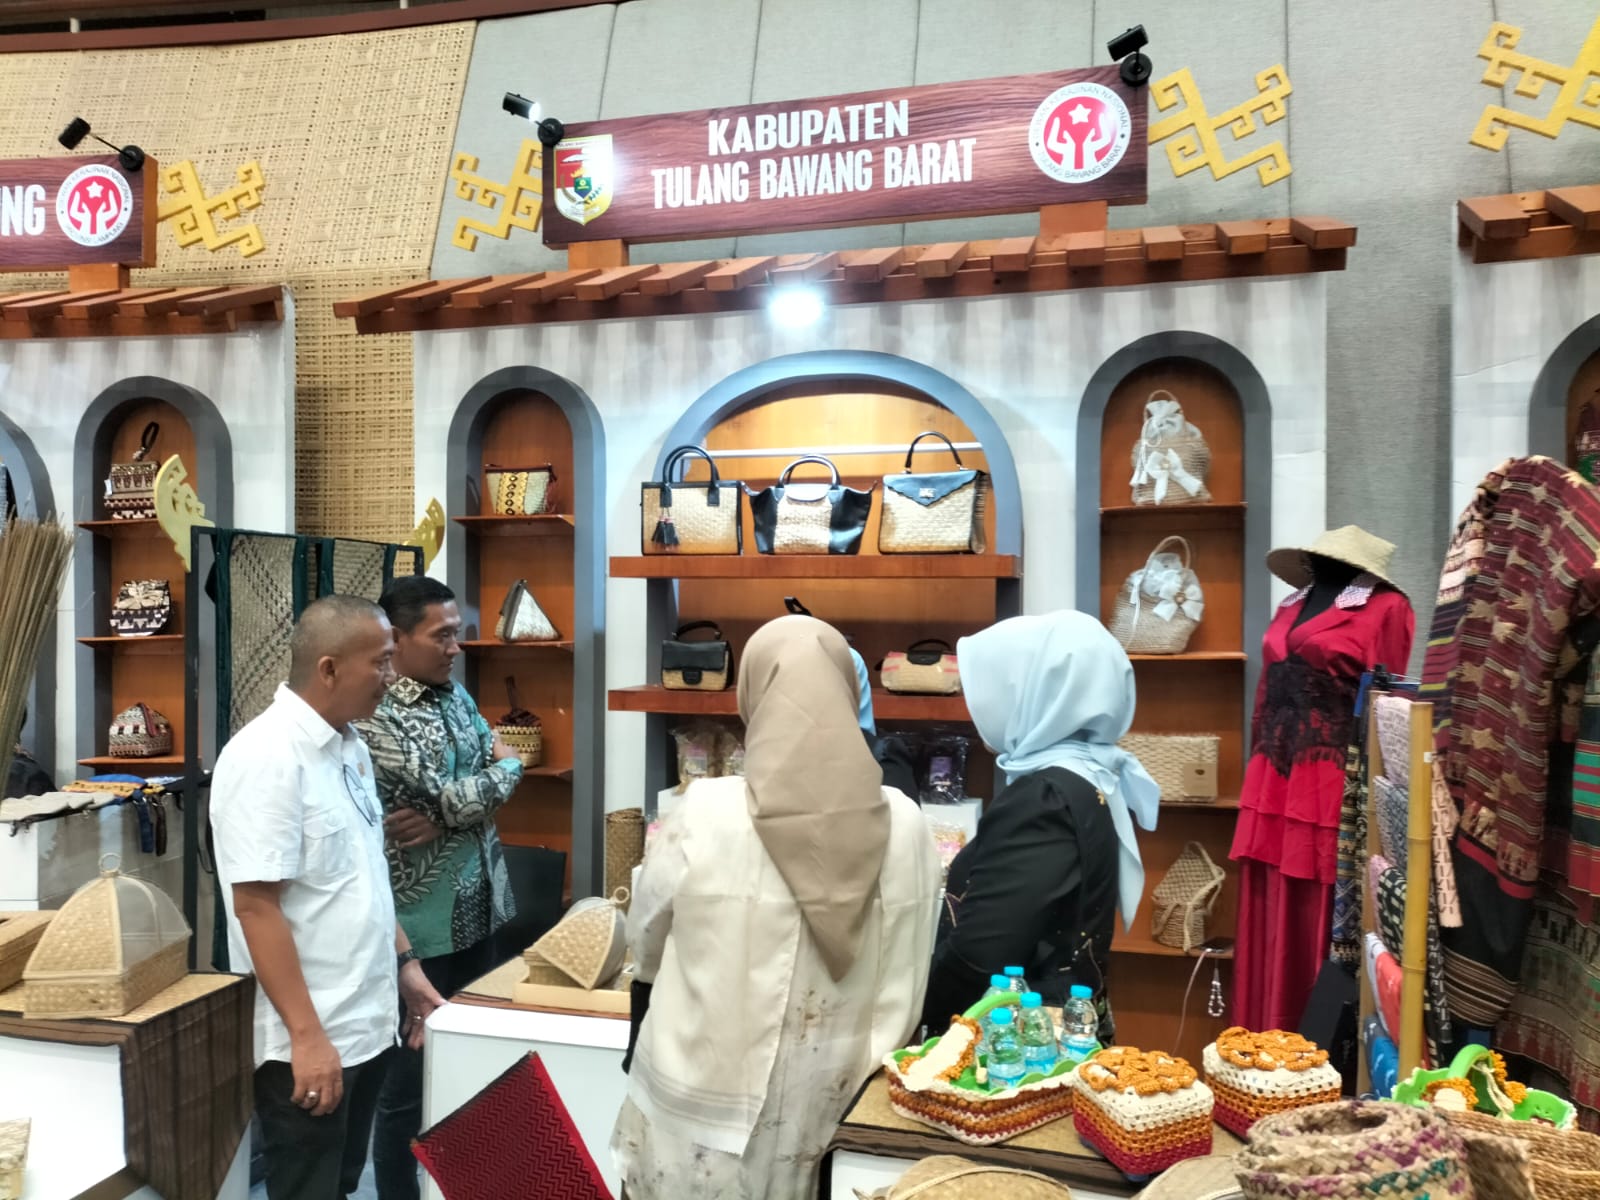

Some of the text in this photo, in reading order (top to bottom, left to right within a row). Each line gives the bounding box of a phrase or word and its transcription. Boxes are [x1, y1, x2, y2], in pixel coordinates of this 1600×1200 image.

[708, 98, 909, 157] KABUPATEN
[650, 138, 977, 209] TULANG BAWANG BARAT
[1102, 144, 1122, 169] BARAT
[0, 184, 46, 237] NG
